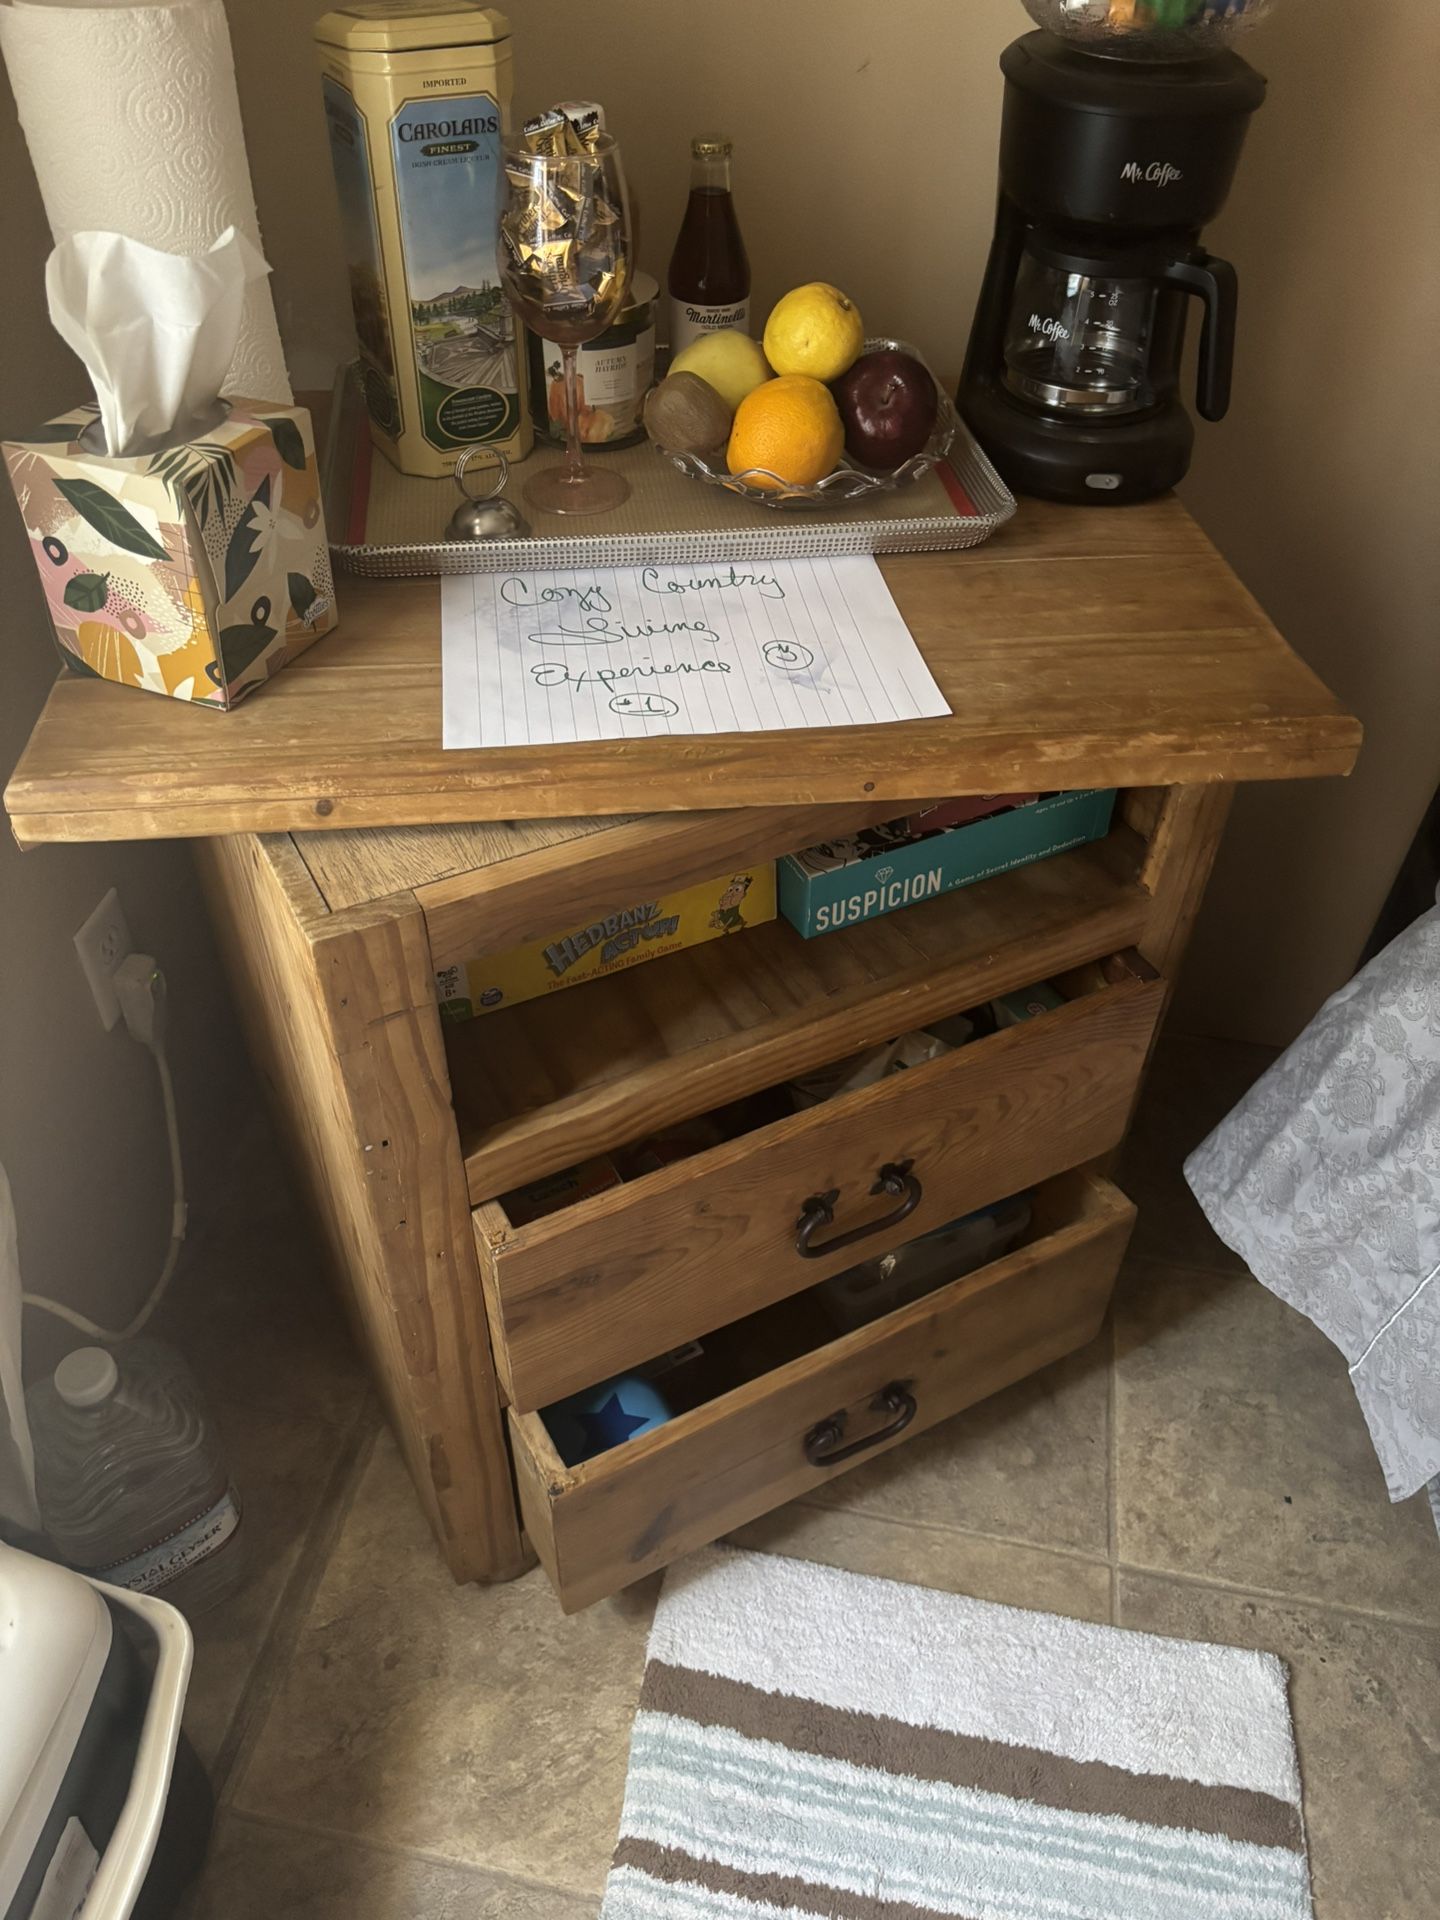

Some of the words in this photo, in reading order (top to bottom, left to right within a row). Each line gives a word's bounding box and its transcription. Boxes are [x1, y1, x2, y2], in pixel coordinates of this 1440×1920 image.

[422, 78, 467, 89] IMPORTED
[398, 115, 498, 143] CAROLANS
[429, 143, 471, 155] FINEST
[411, 160, 432, 169] IRISH
[433, 158, 458, 167] CREAM
[1120, 162, 1143, 184] Mr.
[1145, 161, 1183, 188] Coffee
[1042, 318, 1070, 342] Coffee
[595, 355, 627, 367] AUTUMN
[500, 577, 612, 613] Cozy
[642, 566, 786, 600] Country
[528, 617, 720, 646] Living
[530, 656, 732, 694] Experience
[954, 874, 975, 886] Game
[976, 870, 985, 878] of
[985, 862, 1009, 875] Secret
[1010, 853, 1037, 867] Identity
[1038, 847, 1051, 856] and
[1051, 835, 1086, 852] Deduction
[816, 867, 943, 932] SUSPICION
[543, 901, 663, 977] HEDBANZ
[547, 978, 565, 990] The
[566, 960, 625, 984] Fast-ACTING
[626, 949, 656, 967] Family
[656, 941, 682, 955] Game
[121, 1564, 165, 1589] YSTAL
